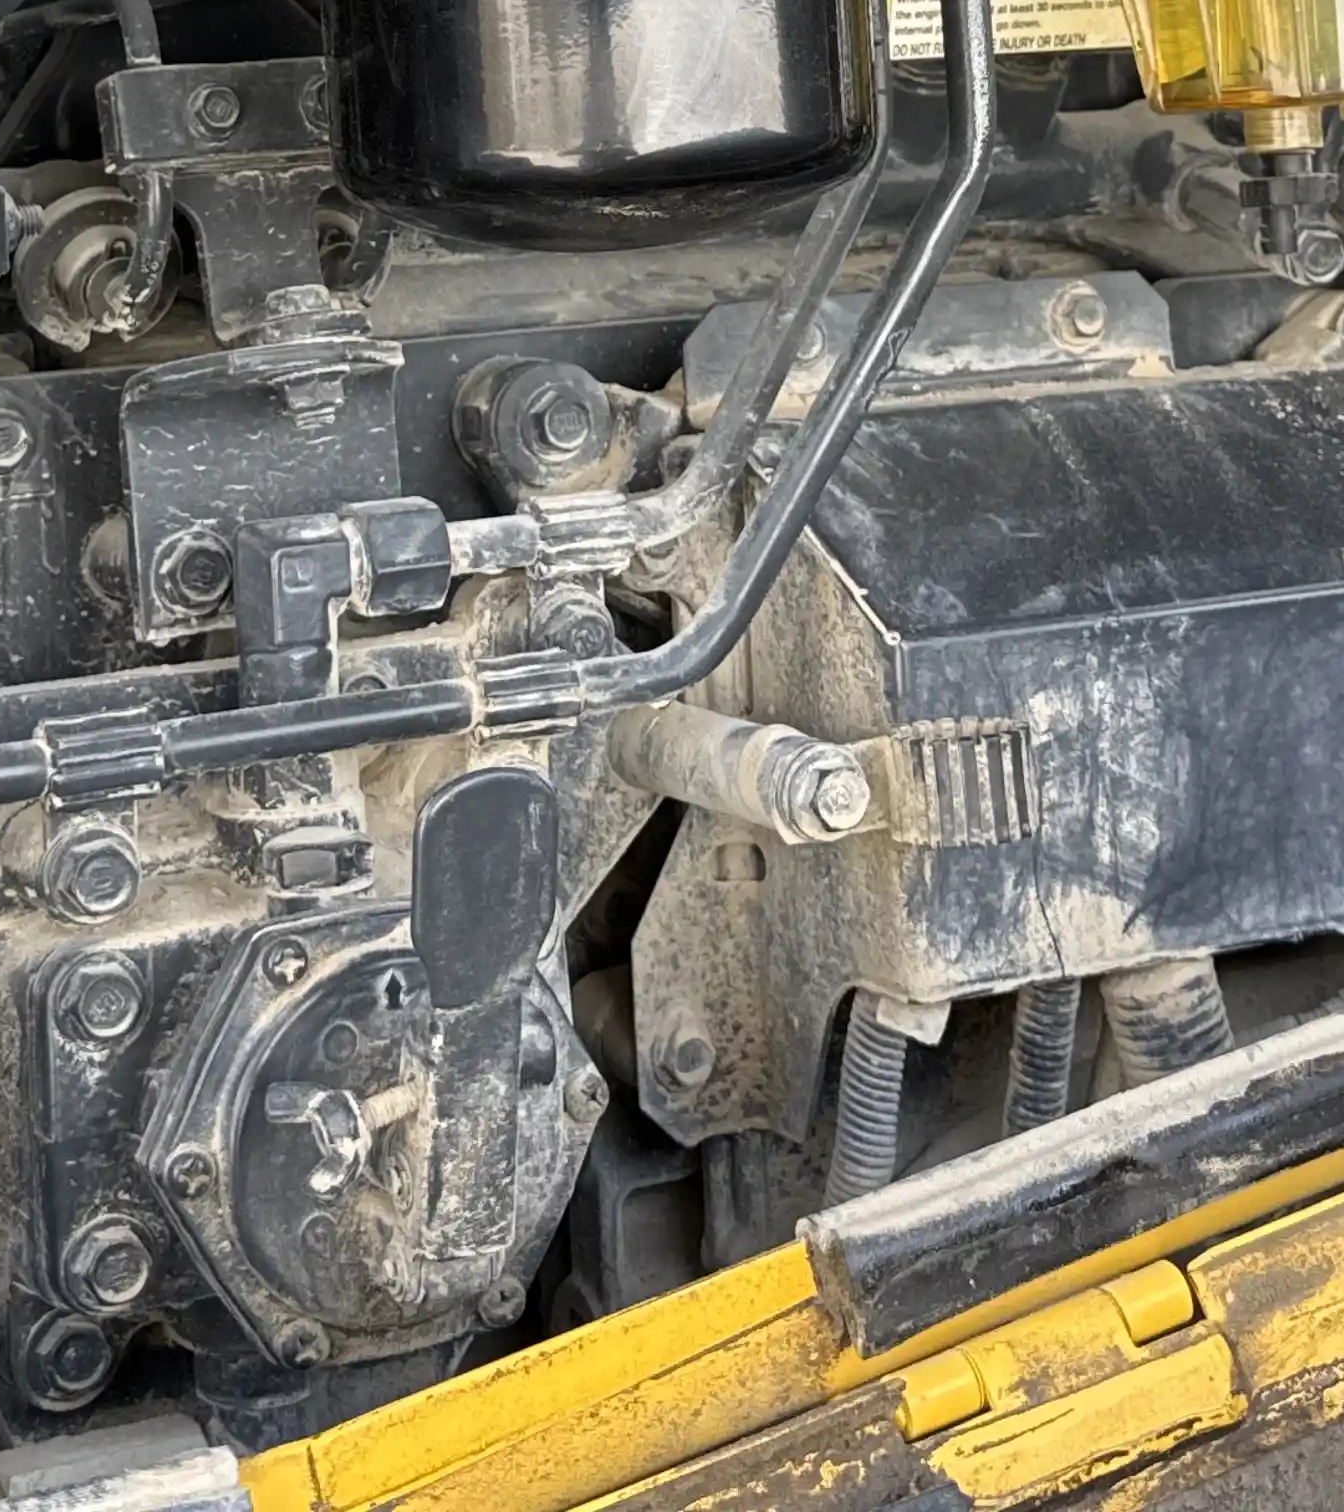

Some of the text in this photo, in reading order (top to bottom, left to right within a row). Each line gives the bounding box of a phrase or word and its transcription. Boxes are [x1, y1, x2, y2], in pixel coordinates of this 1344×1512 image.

[893, 43, 907, 57] DO
[911, 42, 932, 56] NOT
[999, 37, 1035, 50] INJURY
[1037, 35, 1051, 47] OR
[1054, 33, 1086, 47] DEATH
